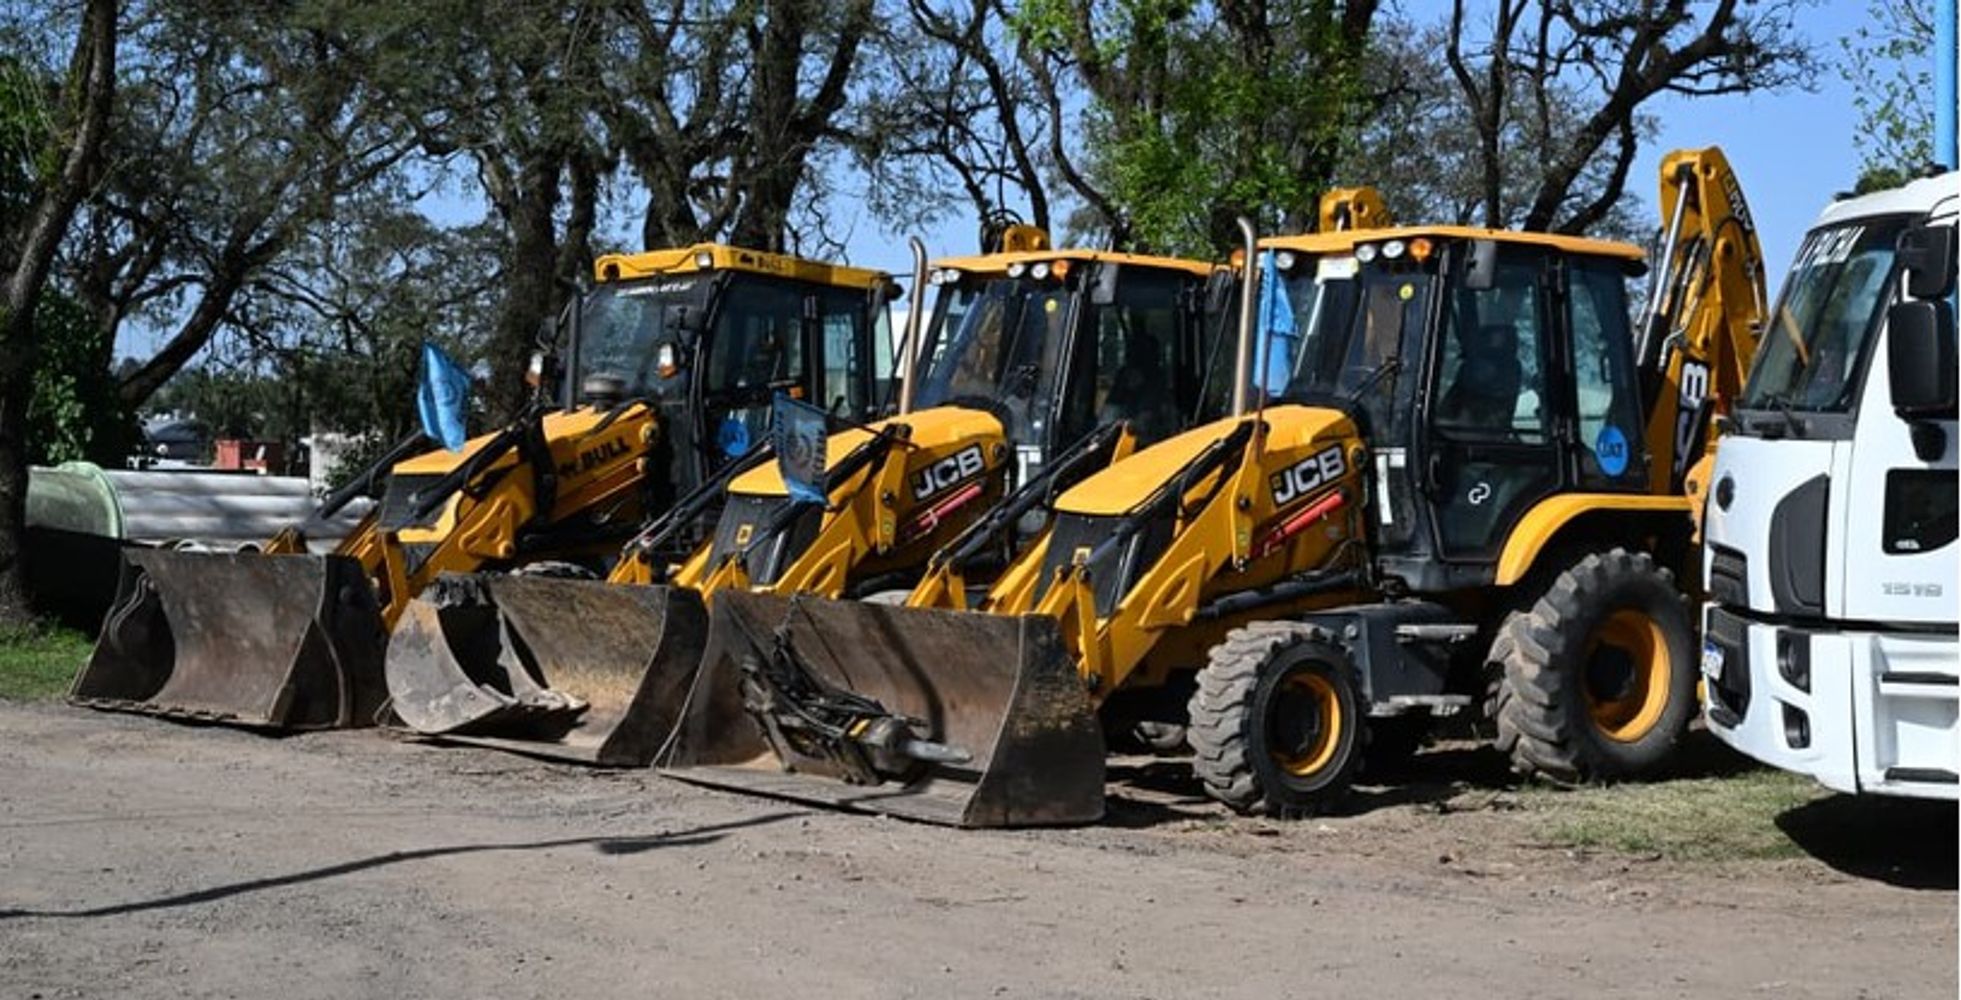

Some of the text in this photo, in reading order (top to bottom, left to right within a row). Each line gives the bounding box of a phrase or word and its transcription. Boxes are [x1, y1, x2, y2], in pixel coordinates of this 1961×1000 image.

[580, 436, 631, 469] BULL
[916, 446, 984, 499] JCB
[1275, 446, 1345, 503] JCB
